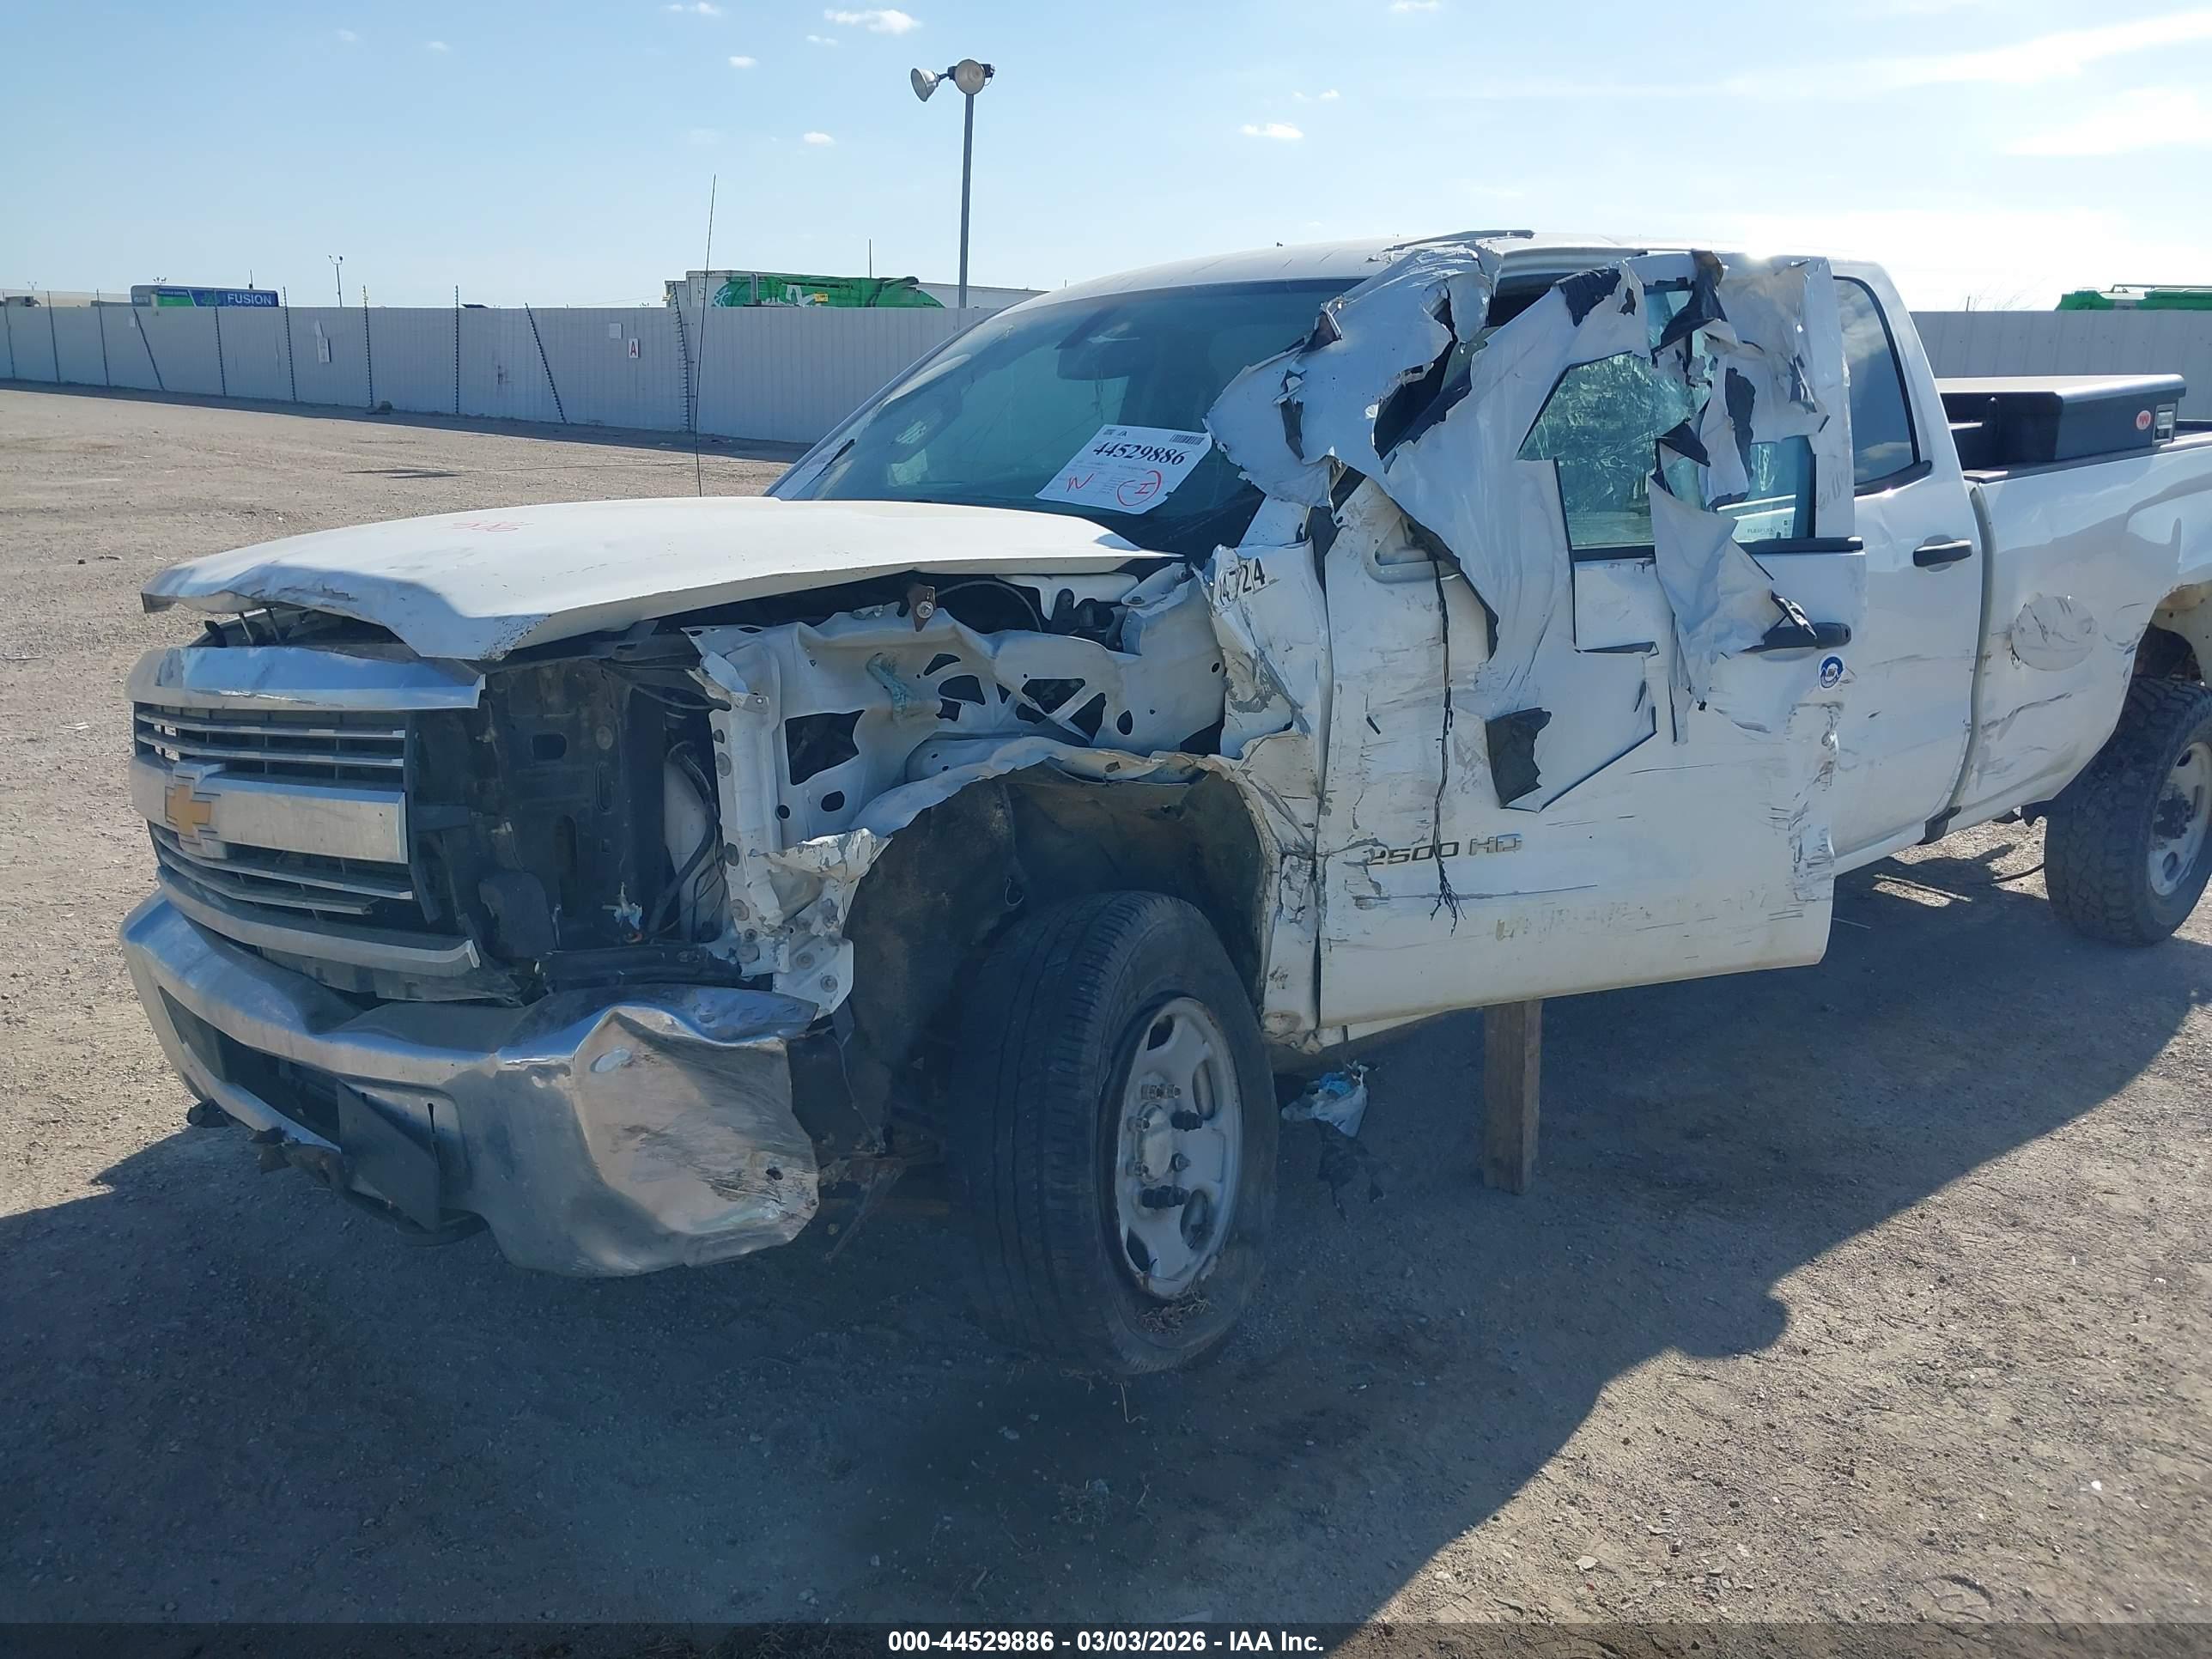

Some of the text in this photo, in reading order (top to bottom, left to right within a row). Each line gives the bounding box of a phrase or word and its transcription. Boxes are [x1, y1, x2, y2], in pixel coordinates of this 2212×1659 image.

[228, 293, 272, 305] FUSION
[629, 340, 637, 356] A
[1093, 441, 1191, 465] 44529886
[1367, 833, 1522, 866] 2500 HD
